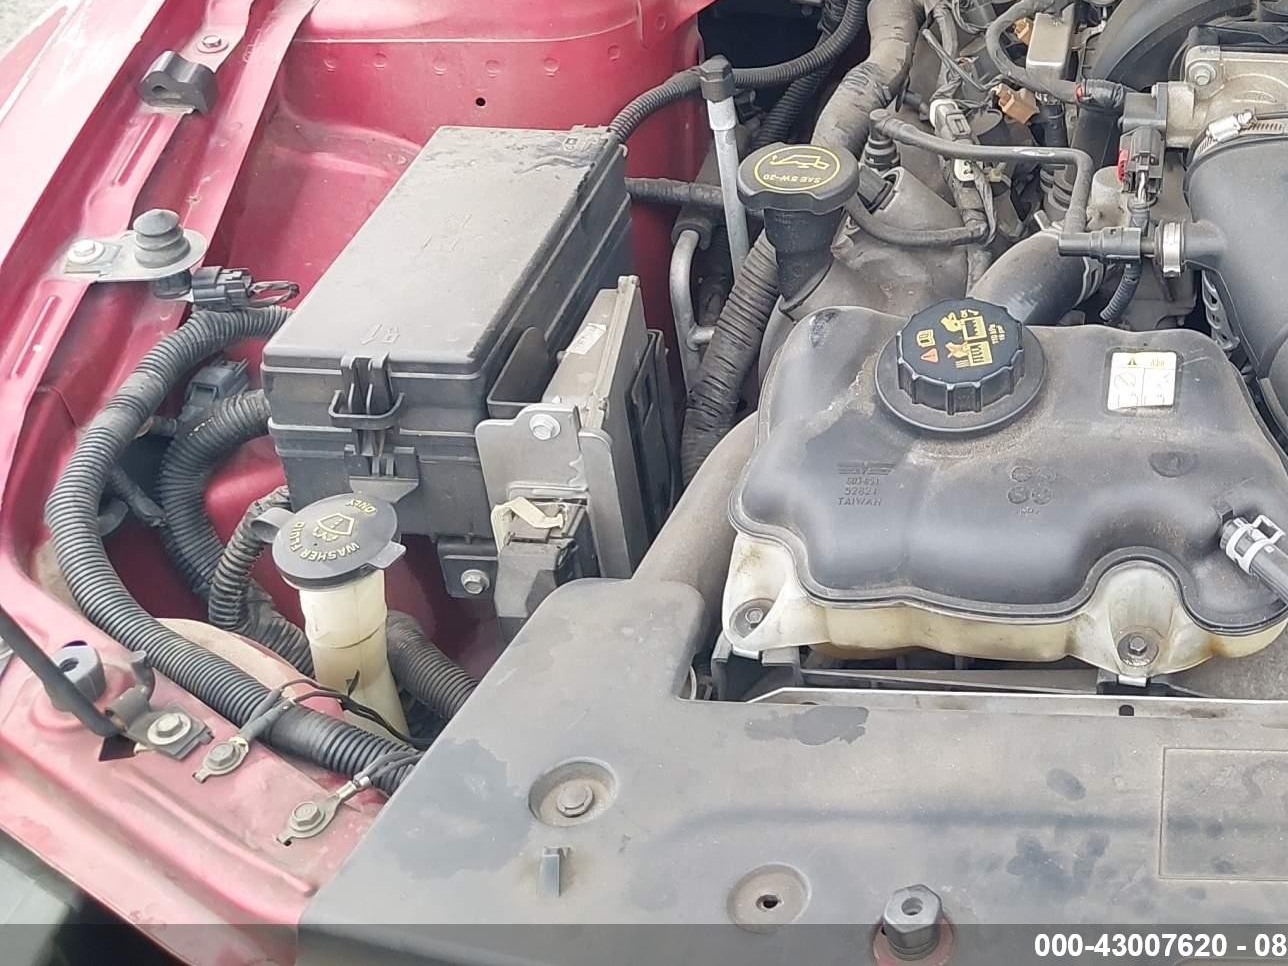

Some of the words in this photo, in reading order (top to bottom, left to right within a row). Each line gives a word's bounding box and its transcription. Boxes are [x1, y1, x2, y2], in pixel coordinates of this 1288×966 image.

[762, 173, 799, 183] 5W-20
[800, 176, 823, 184] SAE
[345, 498, 378, 515] ONLY
[837, 497, 882, 507] TAIWAN
[288, 521, 306, 552] FLUID
[299, 540, 361, 562] WASHER
